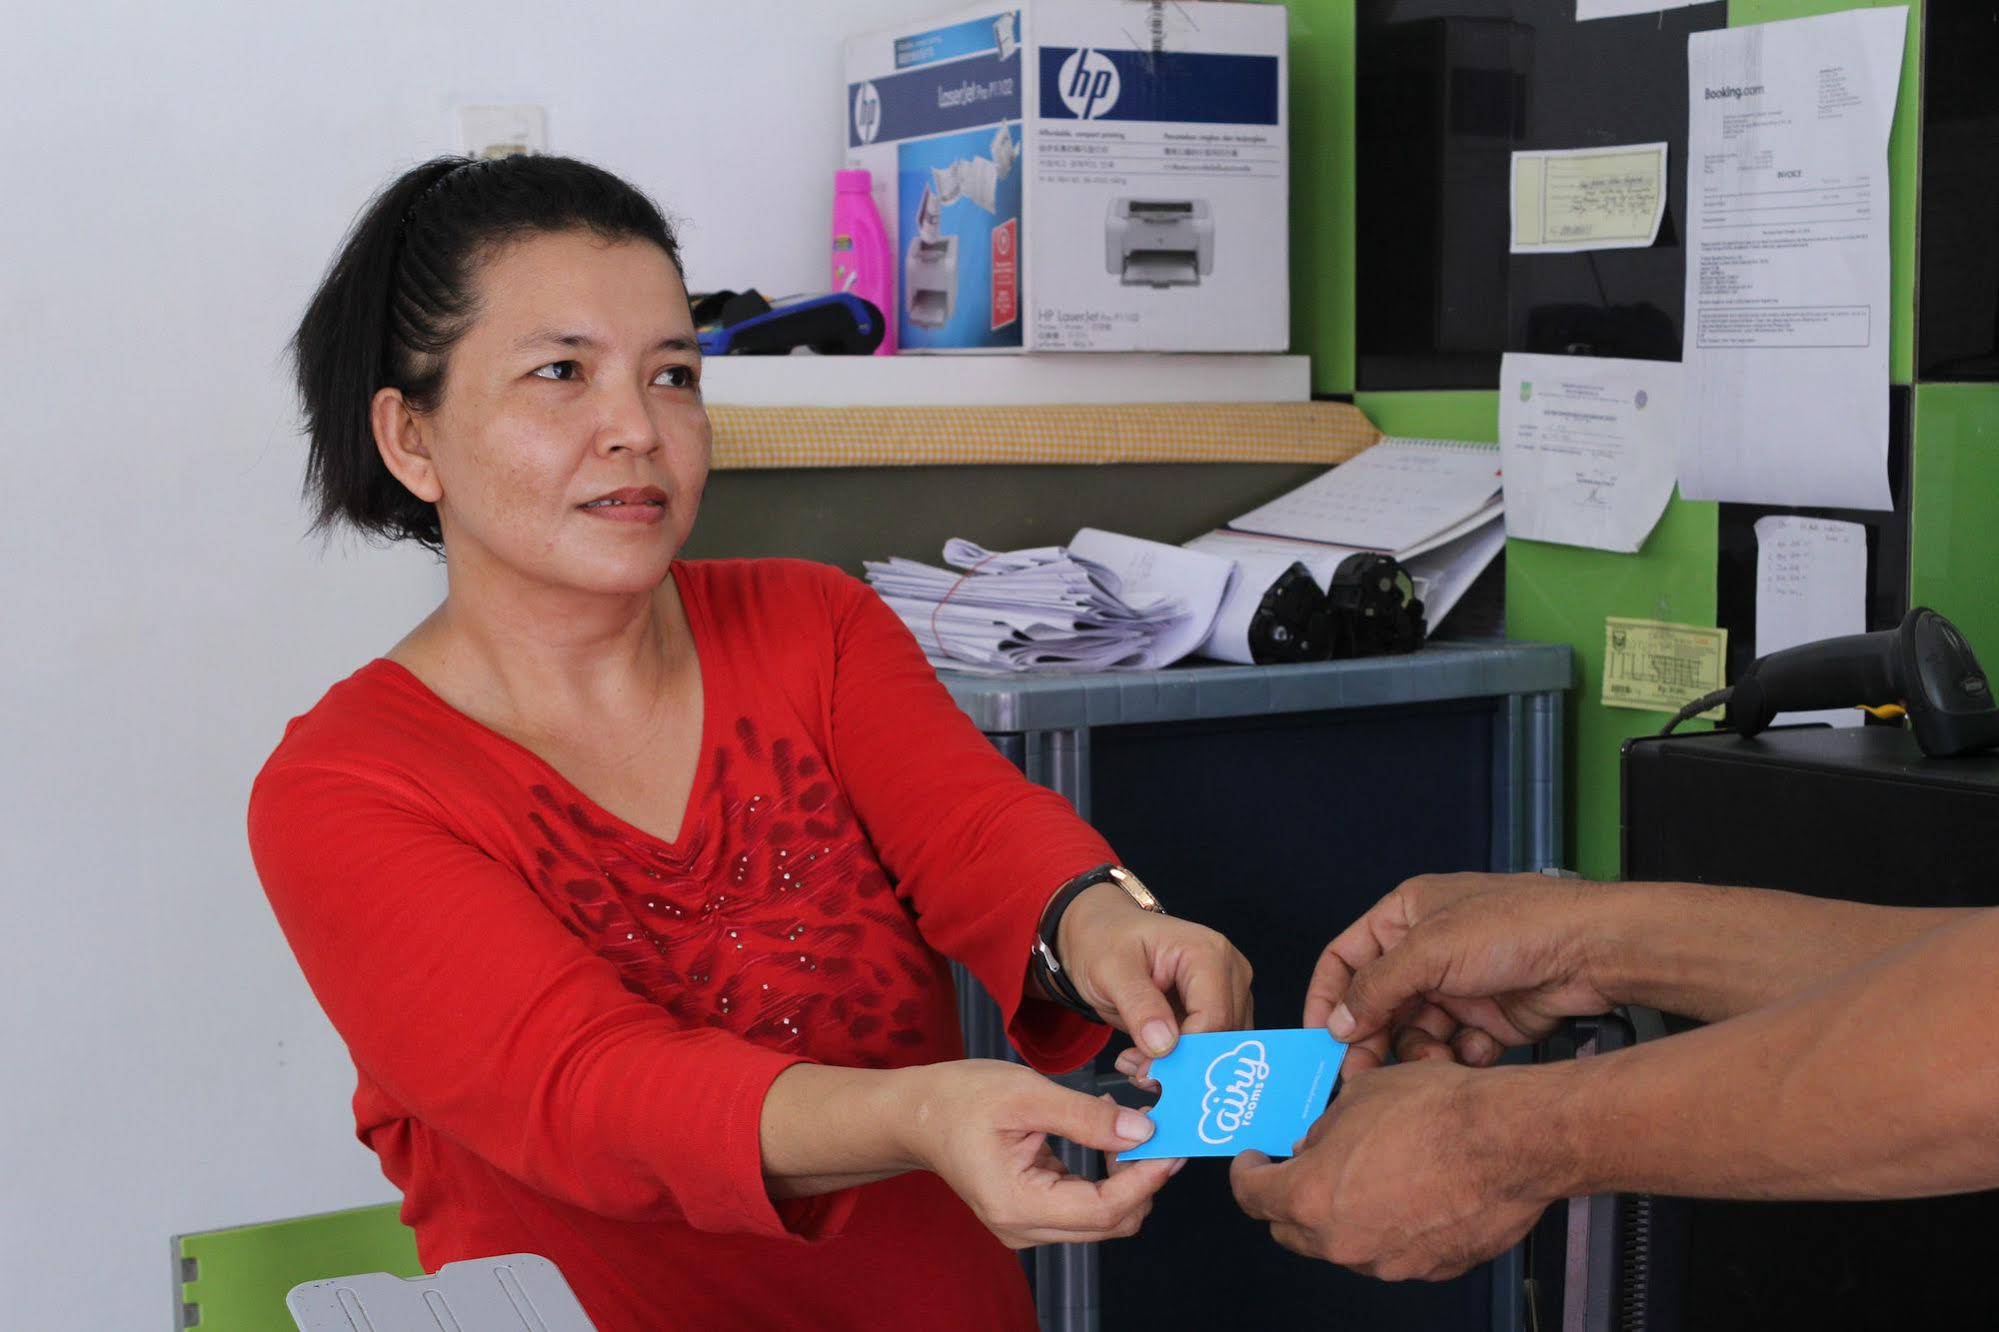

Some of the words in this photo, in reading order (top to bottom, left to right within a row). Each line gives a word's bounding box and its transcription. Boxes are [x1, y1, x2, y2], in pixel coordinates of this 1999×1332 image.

[938, 80, 976, 108] LaserJet
[1067, 48, 1113, 119] hp
[1704, 86, 1765, 100] Booking.com
[857, 81, 877, 145] hp
[1038, 309, 1055, 320] HP
[1058, 310, 1099, 322] LaserJet
[1214, 1054, 1270, 1132] airy
[1242, 1082, 1265, 1126] rooms
